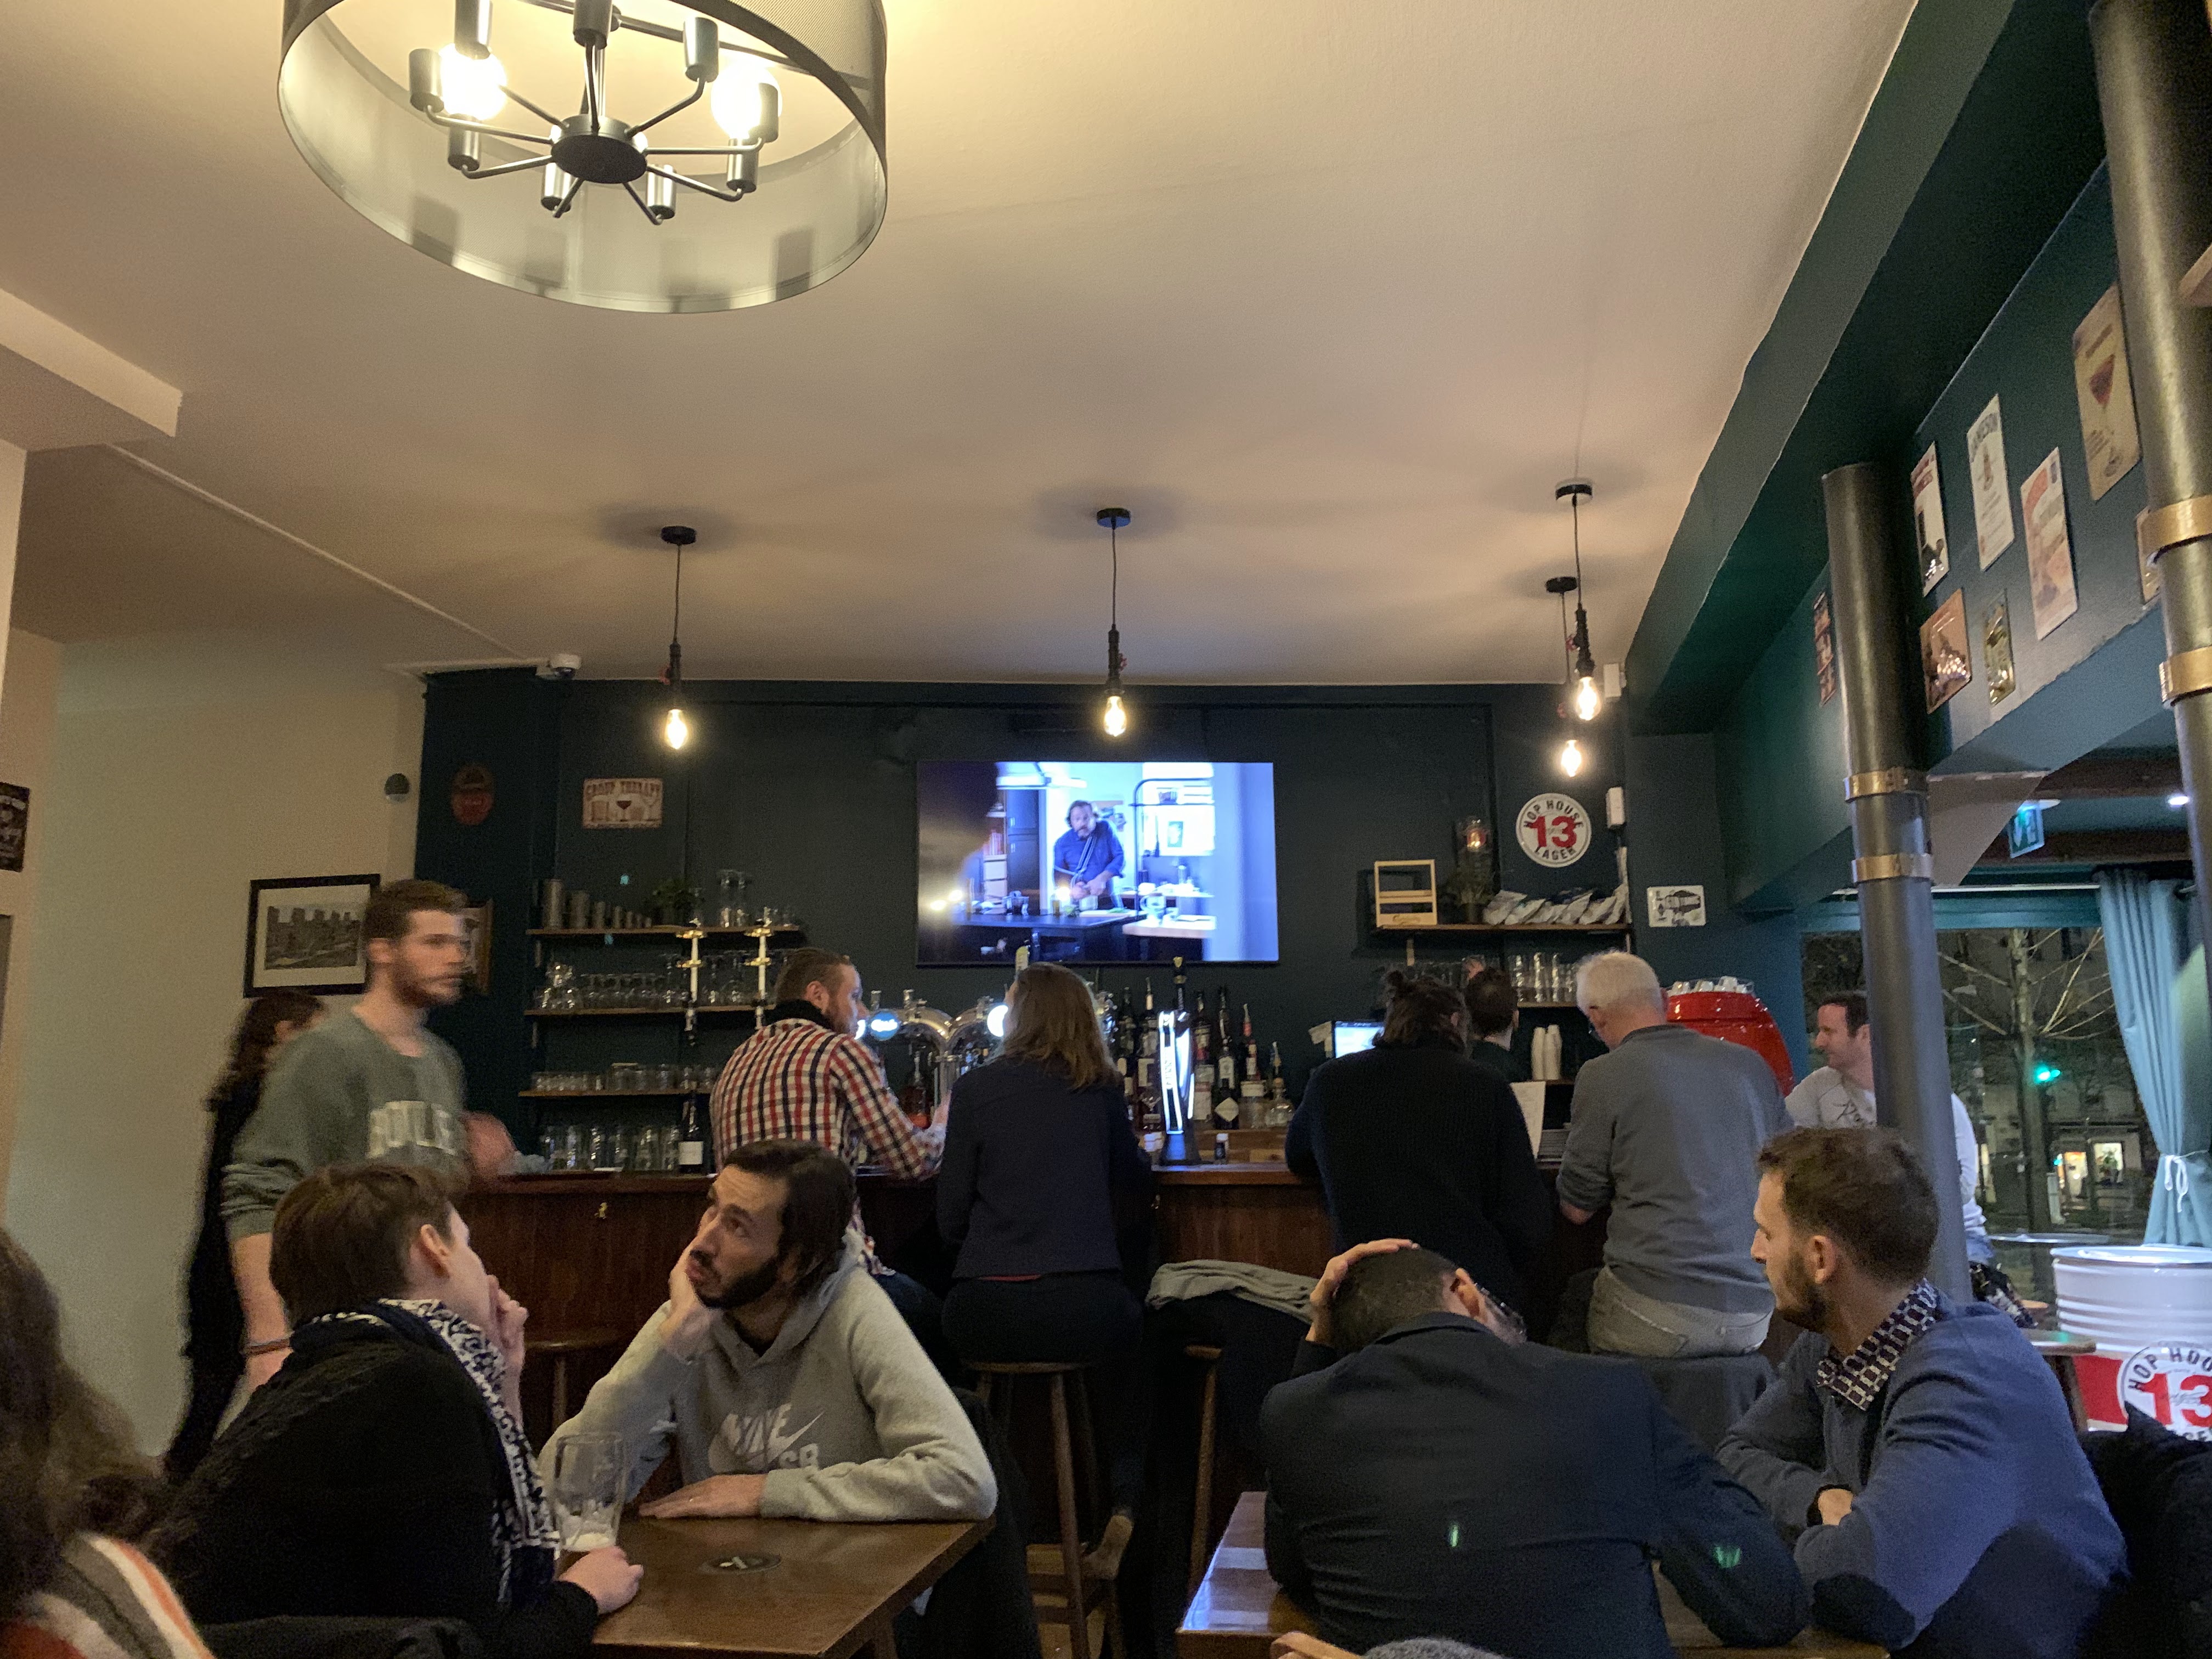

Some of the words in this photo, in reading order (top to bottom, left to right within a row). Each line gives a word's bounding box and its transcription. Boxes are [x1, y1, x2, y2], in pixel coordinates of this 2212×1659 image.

[1523, 804, 1541, 828] HOP
[1546, 800, 1584, 827] HOUSE
[1530, 815, 1577, 848] 13
[1534, 846, 1576, 860] LAGER
[2128, 1355, 2158, 1392] HOP
[2142, 1373, 2212, 1427] 13
